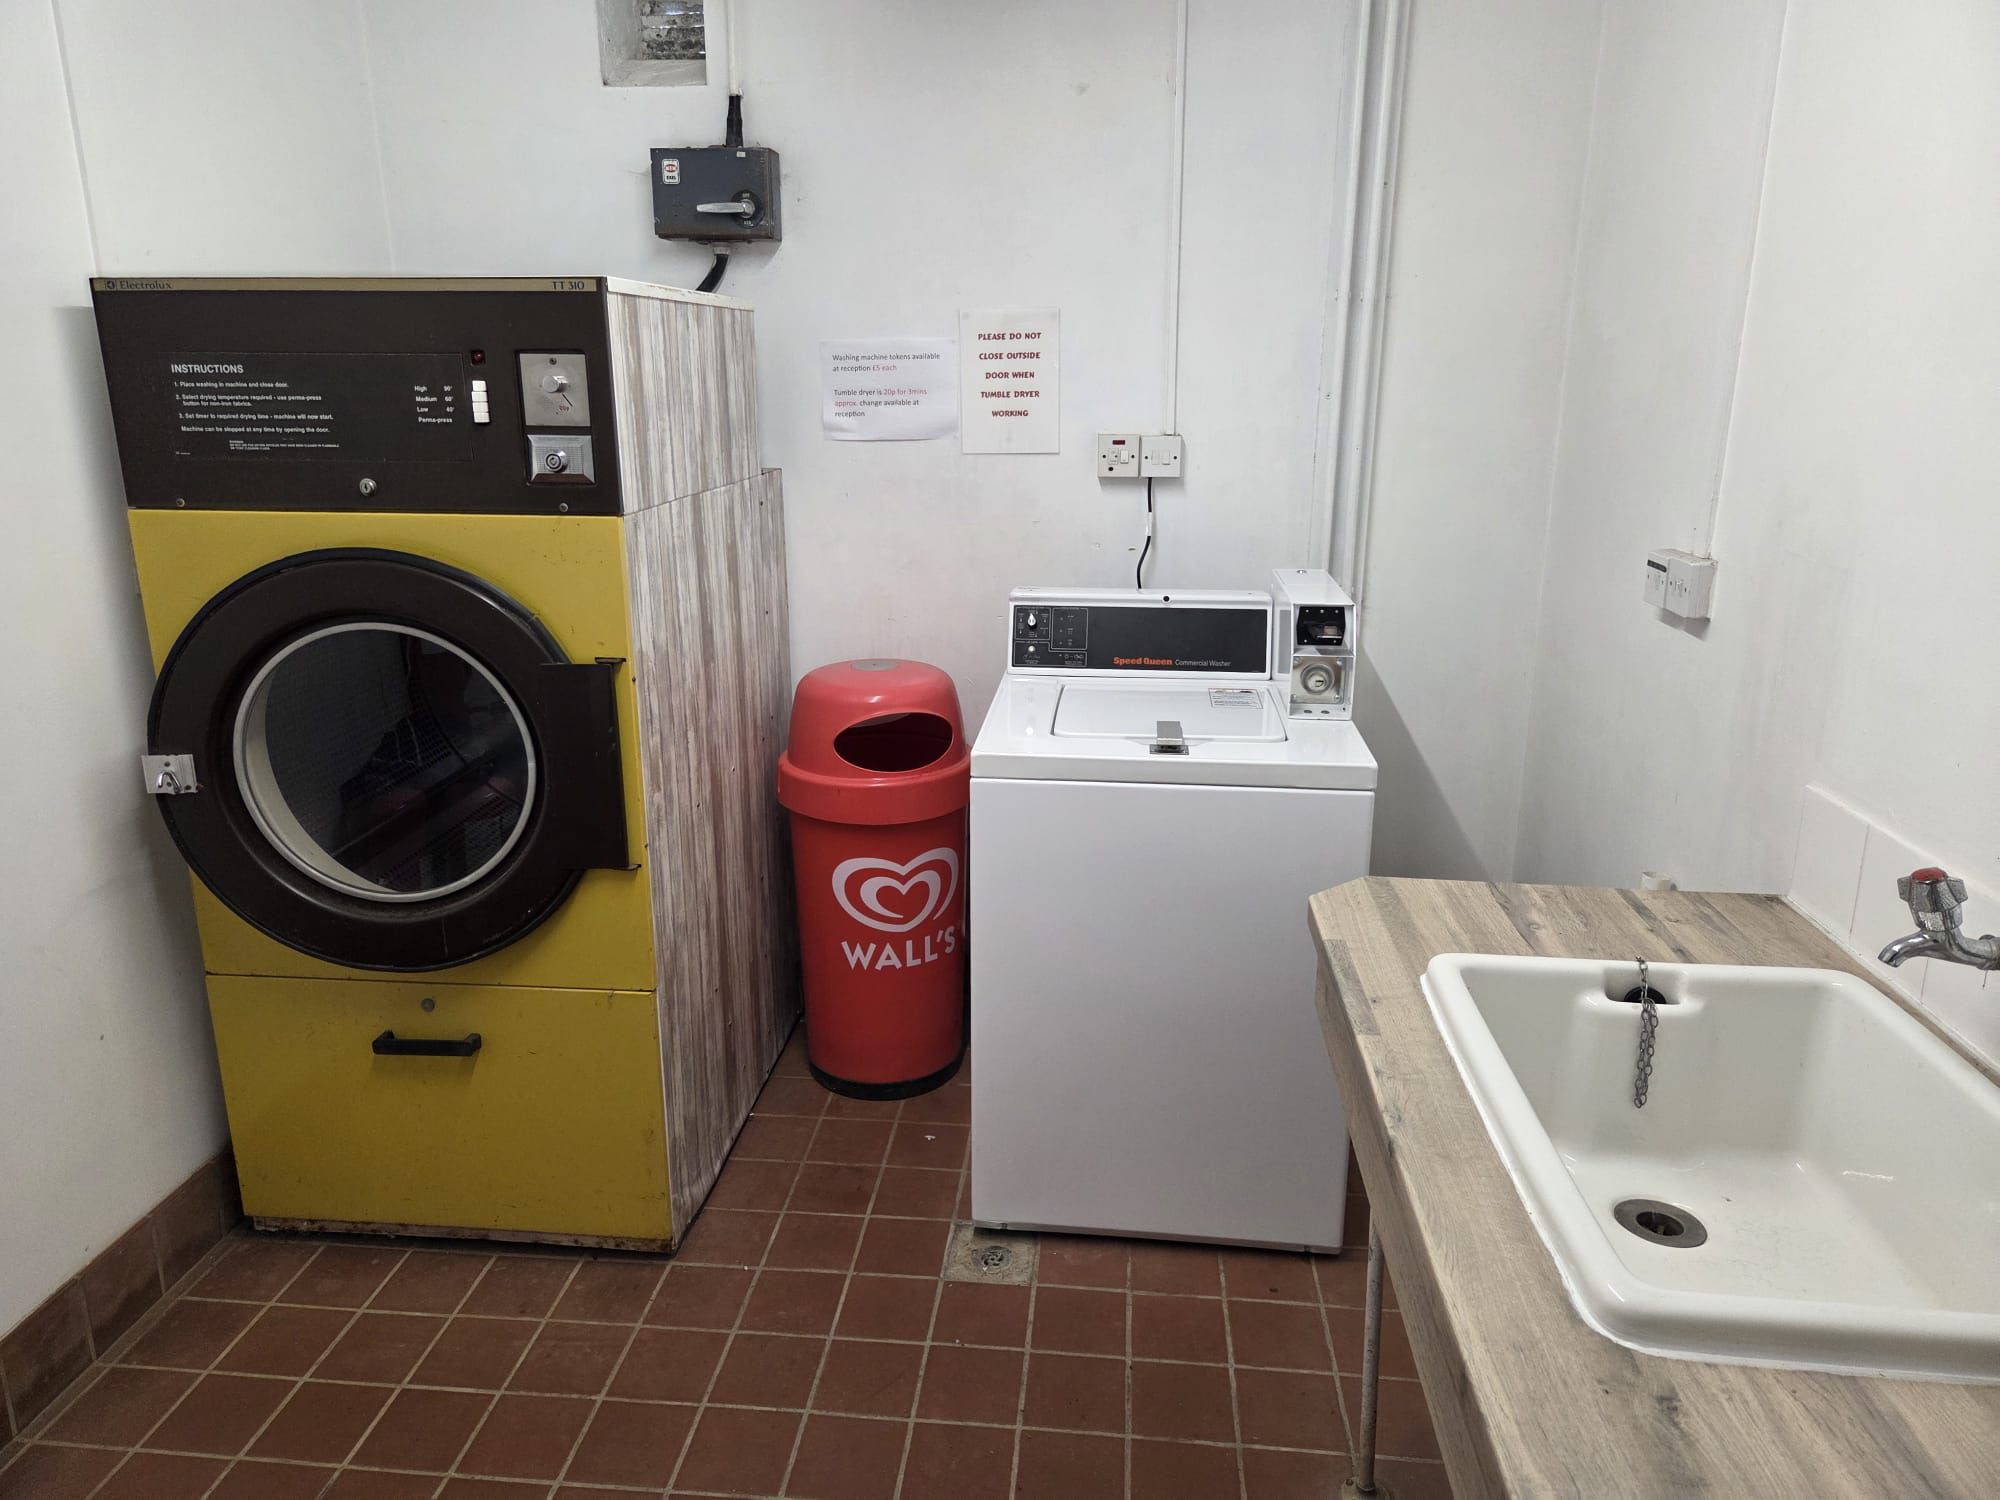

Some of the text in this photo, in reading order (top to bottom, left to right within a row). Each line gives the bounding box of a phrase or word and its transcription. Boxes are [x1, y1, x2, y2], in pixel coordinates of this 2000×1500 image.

[120, 280, 172, 289] Electrolux
[552, 281, 584, 290] TT 310
[170, 364, 244, 374] INSTRUCTIONS
[840, 364, 870, 373] reception
[858, 389, 876, 398] dryer
[884, 389, 896, 398] 20p
[860, 400, 882, 408] change
[835, 411, 866, 419] reception
[1113, 656, 1142, 666] Speed
[1143, 657, 1172, 666] Queen
[841, 925, 955, 971] WALL'S
